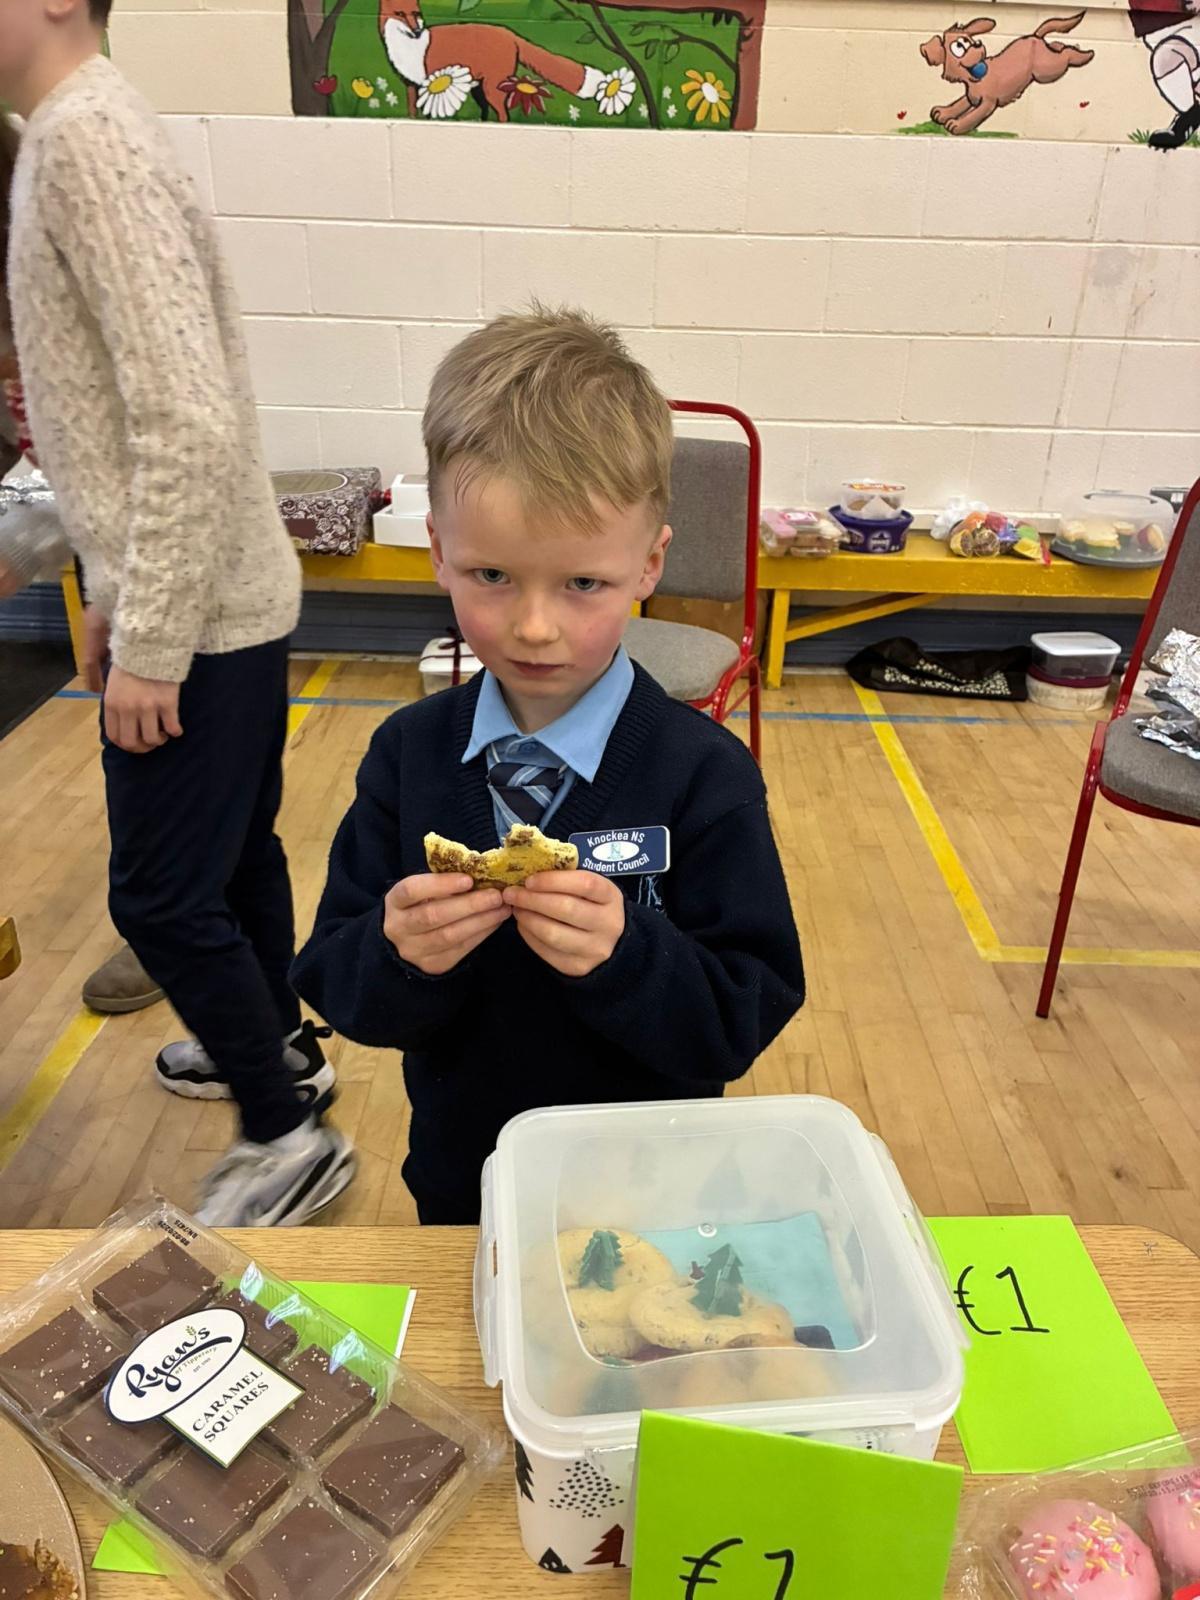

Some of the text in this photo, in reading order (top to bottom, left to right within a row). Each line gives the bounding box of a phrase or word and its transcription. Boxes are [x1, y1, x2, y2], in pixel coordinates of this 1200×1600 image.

[582, 852, 650, 872] Student Council
[586, 830, 645, 848] Knockea NS
[953, 1265, 1050, 1335] €1
[125, 1325, 232, 1398] Ryan's
[192, 1370, 264, 1433] CARAMEL
[204, 1381, 270, 1443] SQUARES
